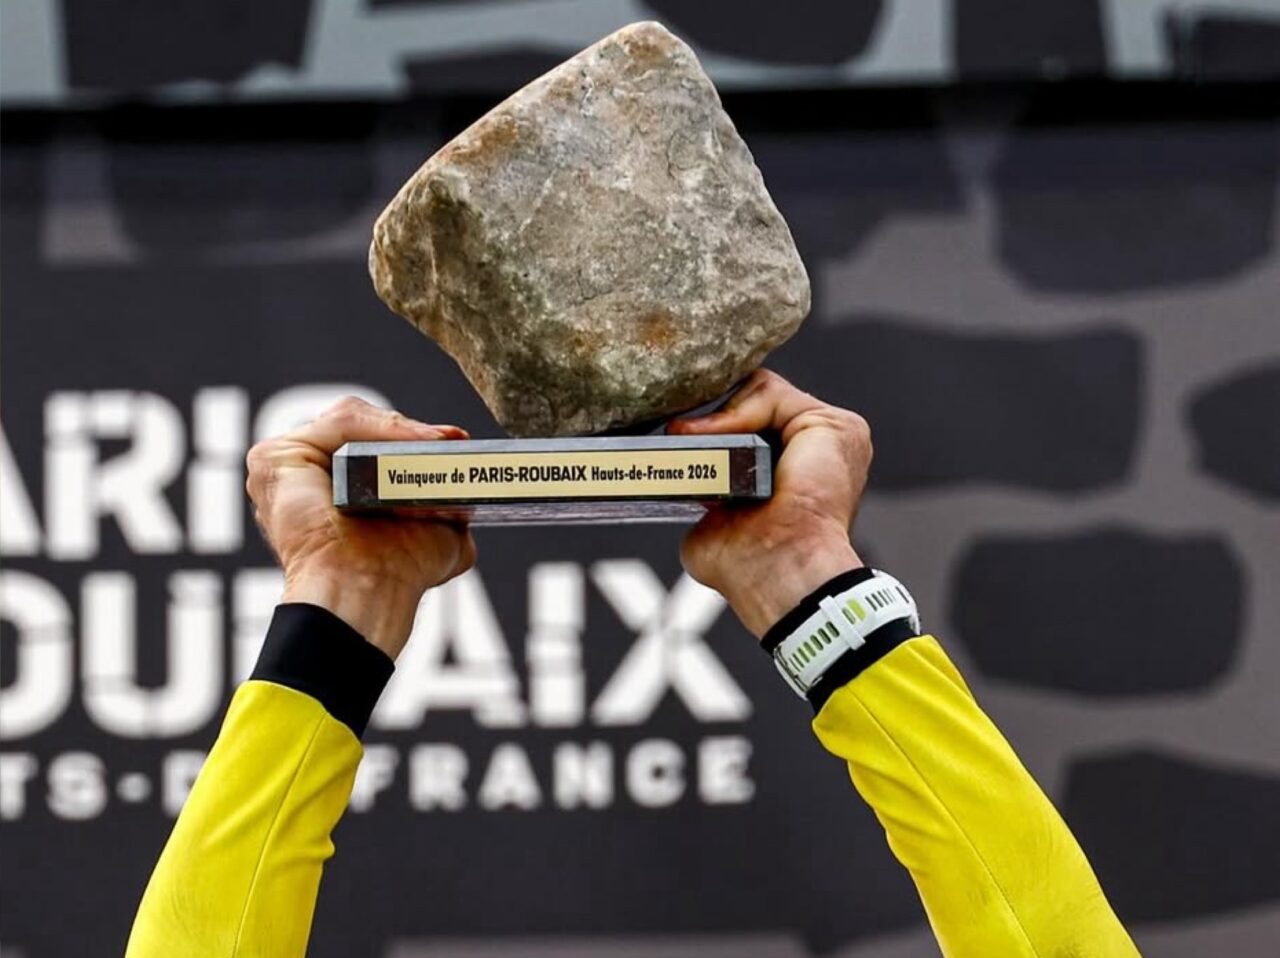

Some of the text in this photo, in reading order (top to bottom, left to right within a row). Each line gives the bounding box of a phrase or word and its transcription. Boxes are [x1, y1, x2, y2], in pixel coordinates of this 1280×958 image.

[388, 464, 717, 487] Vainqueur de PARIS-ROUBAIX Hauts-de-France 2026
